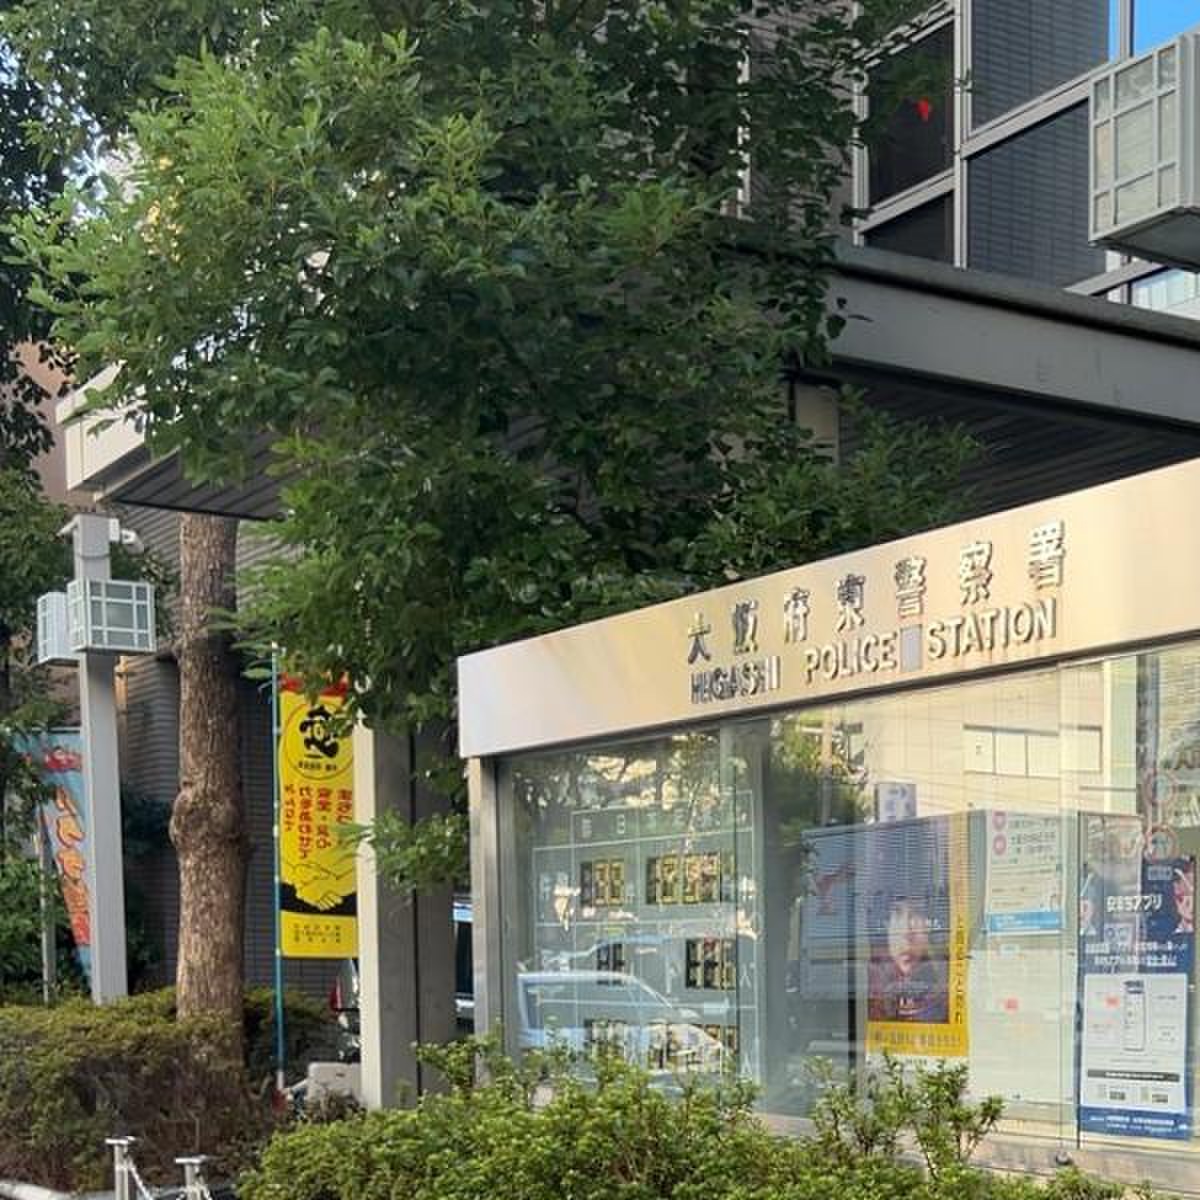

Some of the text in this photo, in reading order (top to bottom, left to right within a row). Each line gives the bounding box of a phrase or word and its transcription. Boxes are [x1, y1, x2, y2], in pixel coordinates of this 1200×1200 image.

[687, 520, 1065, 664] 大阪府東警察署
[804, 632, 898, 684] POLICE
[927, 598, 1057, 661] STATION
